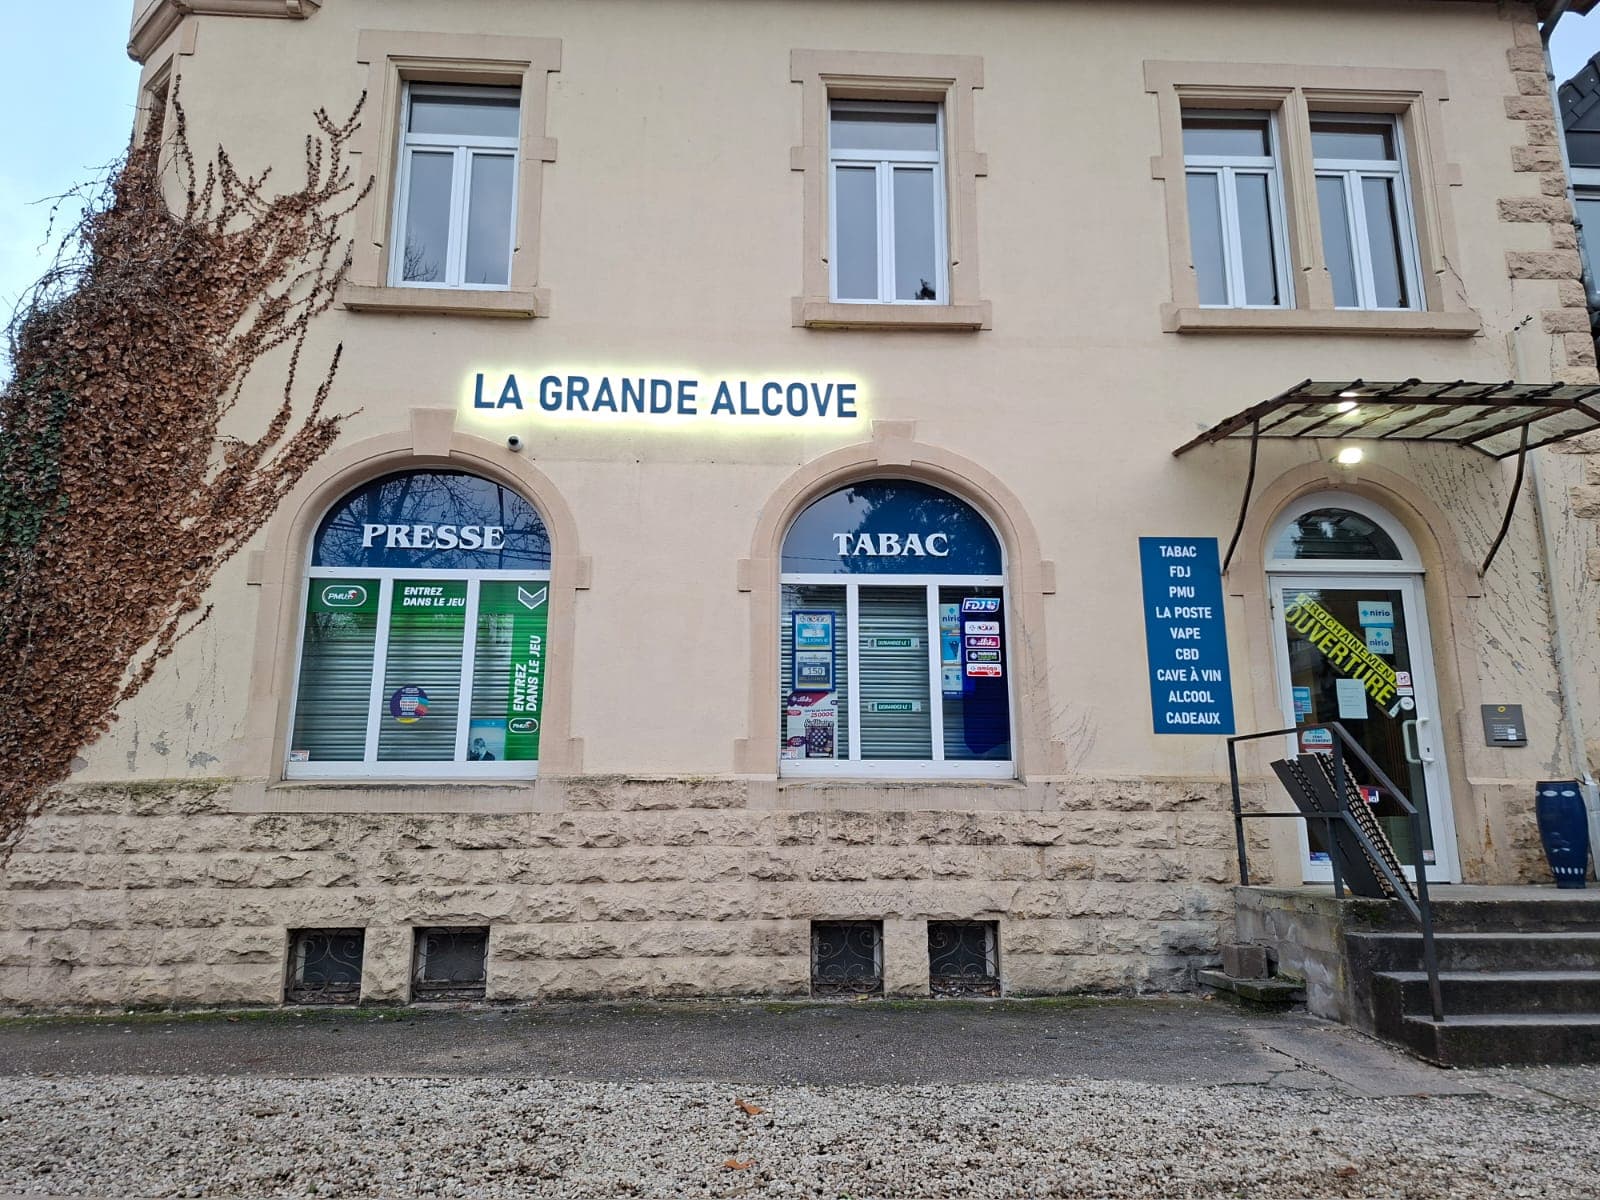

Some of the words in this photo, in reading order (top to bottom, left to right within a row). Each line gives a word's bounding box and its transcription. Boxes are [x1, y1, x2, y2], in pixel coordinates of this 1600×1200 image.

[474, 373, 524, 410] LA
[538, 375, 698, 415] GRANDE
[710, 381, 857, 418] ALCOVE
[362, 523, 506, 550] PRESSE
[832, 533, 950, 557] TABAC
[1159, 545, 1197, 558] TABAC
[1169, 565, 1191, 578] FDJ
[403, 586, 444, 596] ENTREZ
[1168, 586, 1195, 598] PMU
[402, 597, 432, 606] DANS
[433, 598, 445, 606] LE
[446, 598, 465, 607] JEU
[965, 600, 985, 610] FDJ
[1155, 606, 1172, 619] LA
[1174, 606, 1212, 619] POSTE
[1369, 609, 1391, 617] nirio
[1170, 627, 1201, 639] VAPE
[529, 634, 542, 658] JEU
[1369, 639, 1390, 647] nirio
[1175, 648, 1200, 661] CBD
[1284, 602, 1396, 706] OUVERTURE
[528, 659, 540, 674] LE
[807, 667, 823, 675] 150
[1157, 669, 1187, 681] CAVE
[1190, 666, 1199, 681] À
[1201, 669, 1222, 682] VIN
[512, 663, 527, 712] ENTREZ
[525, 676, 539, 712] DANS
[1168, 690, 1215, 703] ALCOOL
[1166, 711, 1221, 725] CADEAUX
